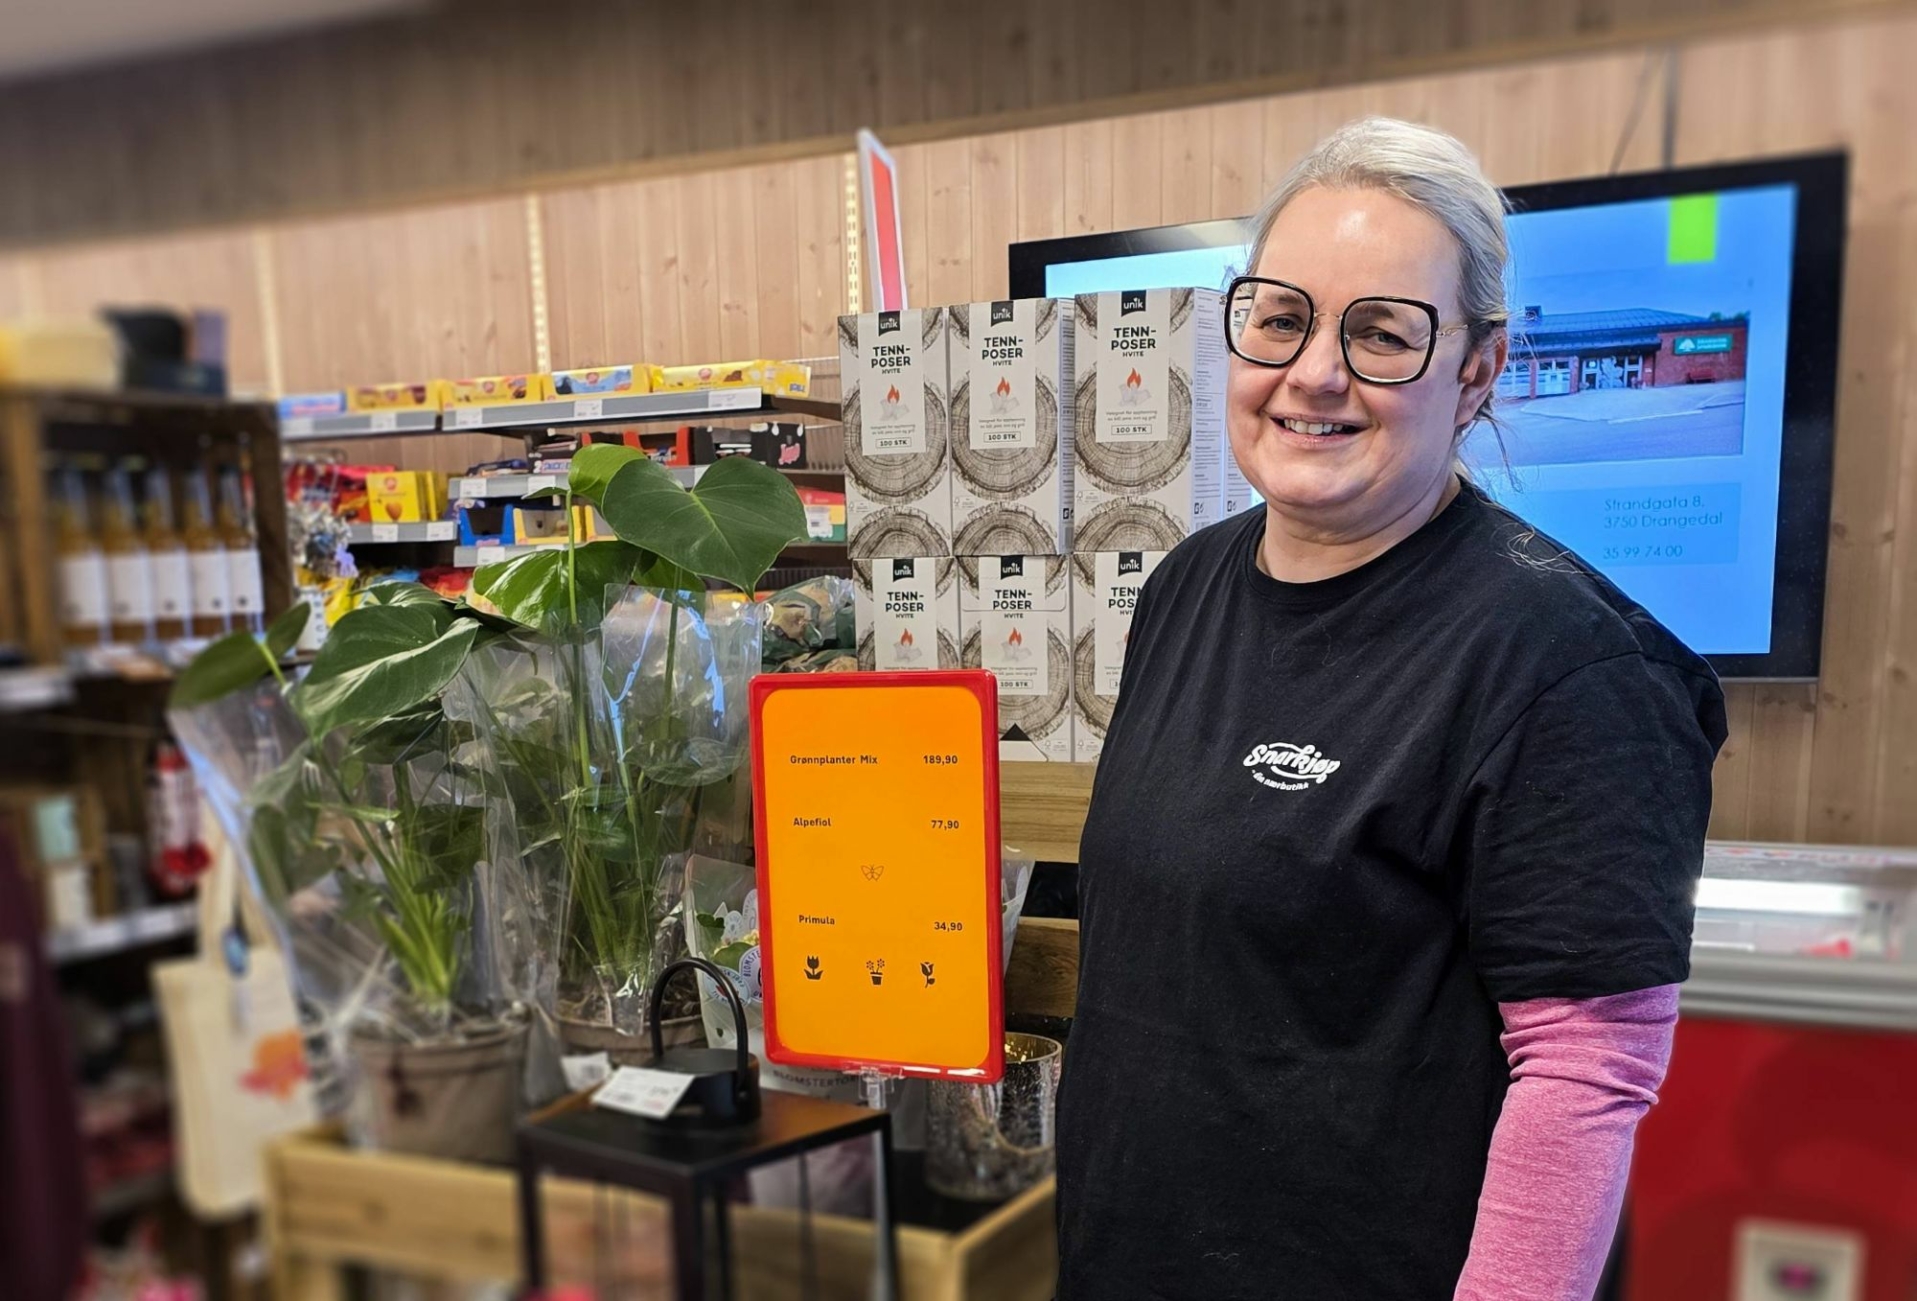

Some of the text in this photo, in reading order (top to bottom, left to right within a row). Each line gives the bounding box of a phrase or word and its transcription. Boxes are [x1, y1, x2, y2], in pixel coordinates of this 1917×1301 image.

[1123, 297, 1144, 310] unik
[992, 308, 1012, 320] unik
[880, 317, 898, 330] unik
[1113, 326, 1157, 338] TENN-
[984, 335, 1024, 348] TENN-
[1111, 338, 1156, 350] POSER
[872, 344, 911, 357] TENN-
[982, 347, 1023, 360] POSER
[871, 356, 911, 369] POSER
[1116, 426, 1131, 434] 100
[1604, 496, 1687, 512] Strandgata
[1603, 511, 1723, 529] 3750 Drangedal
[1603, 547, 1619, 559] 35
[1624, 546, 1640, 558] 99
[1665, 545, 1682, 557] 00
[894, 564, 912, 576] unik
[1002, 562, 1021, 574] unik
[1120, 558, 1140, 570] unik
[886, 591, 924, 601] TENN-
[994, 589, 1033, 599] TENN-
[1111, 586, 1142, 597] TEN
[885, 602, 924, 612] POSER
[993, 600, 1032, 610] POSER
[1108, 599, 1135, 608] POS
[790, 755, 958, 766] Grønnplanter Mix 189,90
[793, 817, 960, 830] Alpefiol 77,90
[798, 914, 963, 932] Primula 34,90
[743, 948, 762, 978] BLOMSTE
